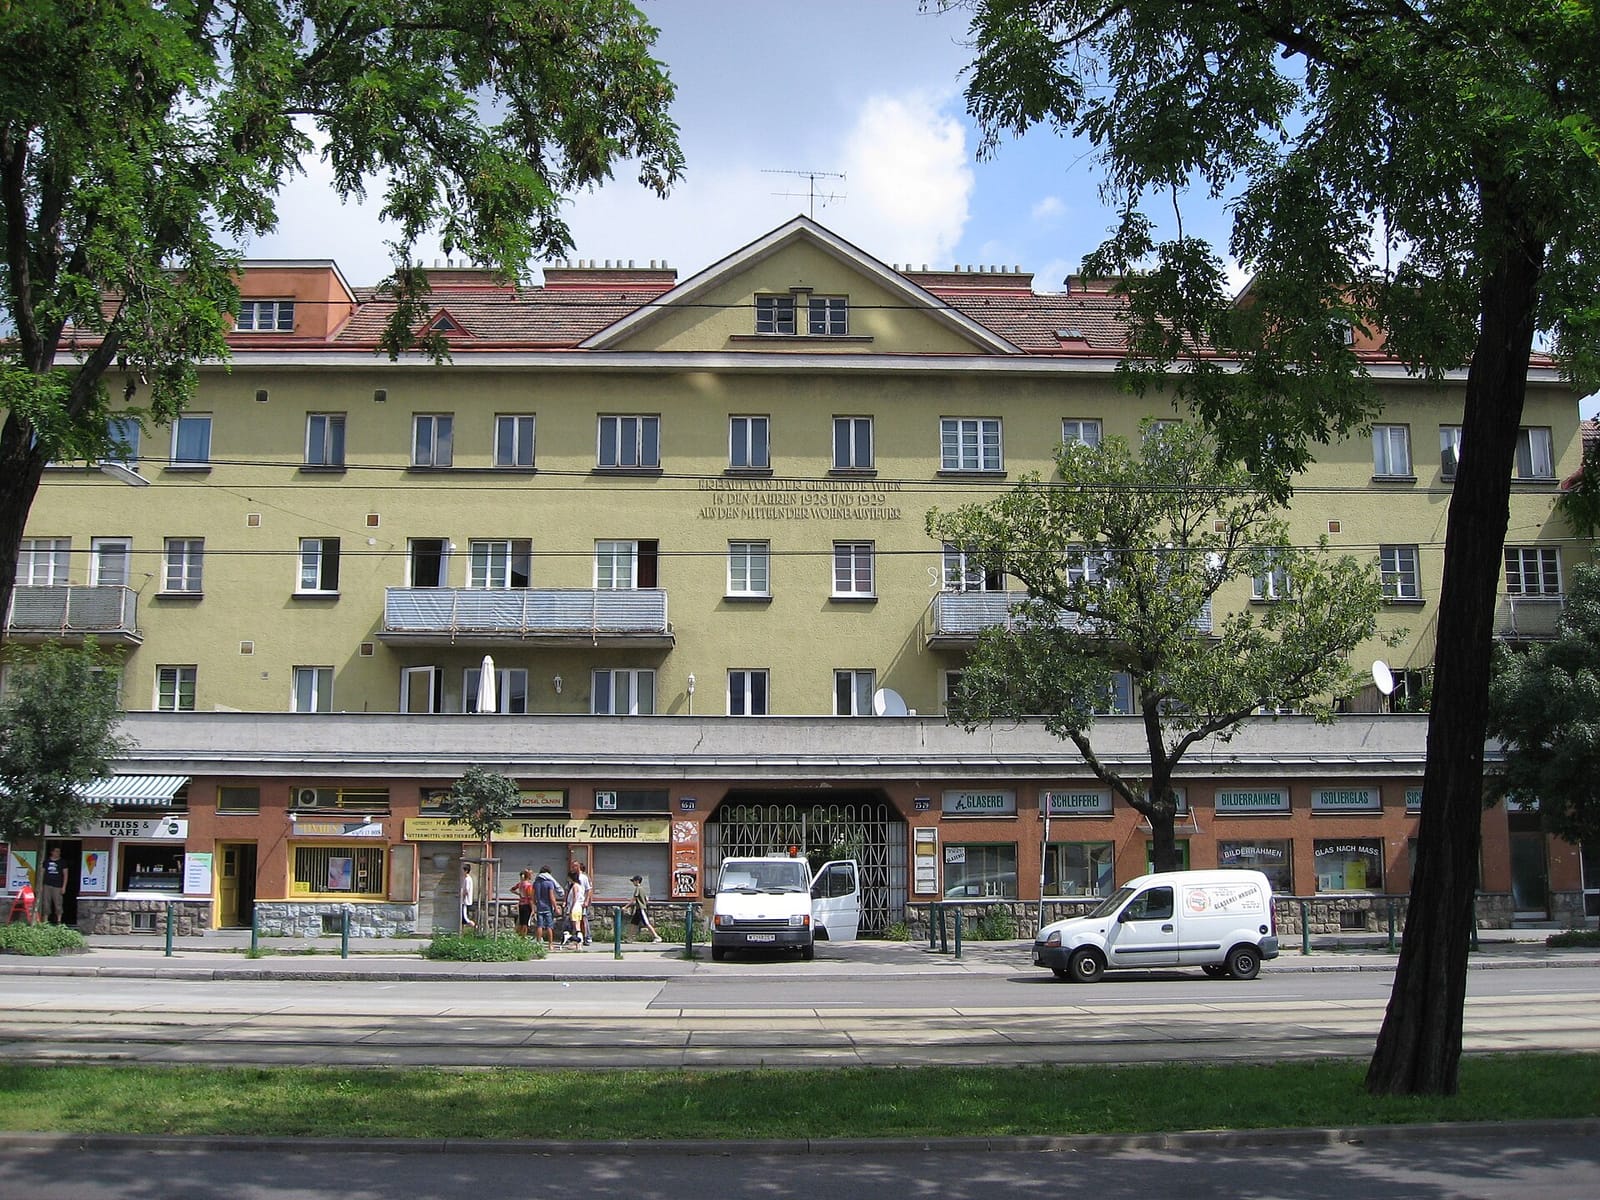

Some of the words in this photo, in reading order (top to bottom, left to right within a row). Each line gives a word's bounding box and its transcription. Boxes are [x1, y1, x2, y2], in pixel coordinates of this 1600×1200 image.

[749, 480, 772, 490] VON
[777, 480, 802, 490] DER
[805, 481, 868, 491] GEMEINDE
[872, 482, 901, 491] WIEN
[713, 493, 723, 506] IN
[728, 493, 749, 506] DEN
[752, 493, 797, 506] JAHREN
[831, 493, 854, 506] UND
[858, 493, 886, 506] 1929
[699, 507, 717, 520] AUS
[718, 507, 739, 520] DEN
[741, 507, 785, 520] MITTELN
[787, 507, 809, 520] DER
[966, 795, 1004, 808] GLASEREI
[1051, 795, 1100, 808] SCHLEIFEREI
[1221, 793, 1281, 806] BILDERRAHMEN
[1320, 792, 1369, 805] ISOLIERGLAS
[100, 821, 139, 829] IMBISS
[142, 821, 149, 829] &
[521, 823, 577, 838] Tierfutter
[590, 823, 639, 838] Zubehör
[1224, 847, 1283, 858] BILDERRAHMEN
[1314, 846, 1335, 857] GLAS
[1336, 844, 1357, 853] NACH
[1358, 845, 1380, 856] MASS
[82, 877, 97, 886] Eis
